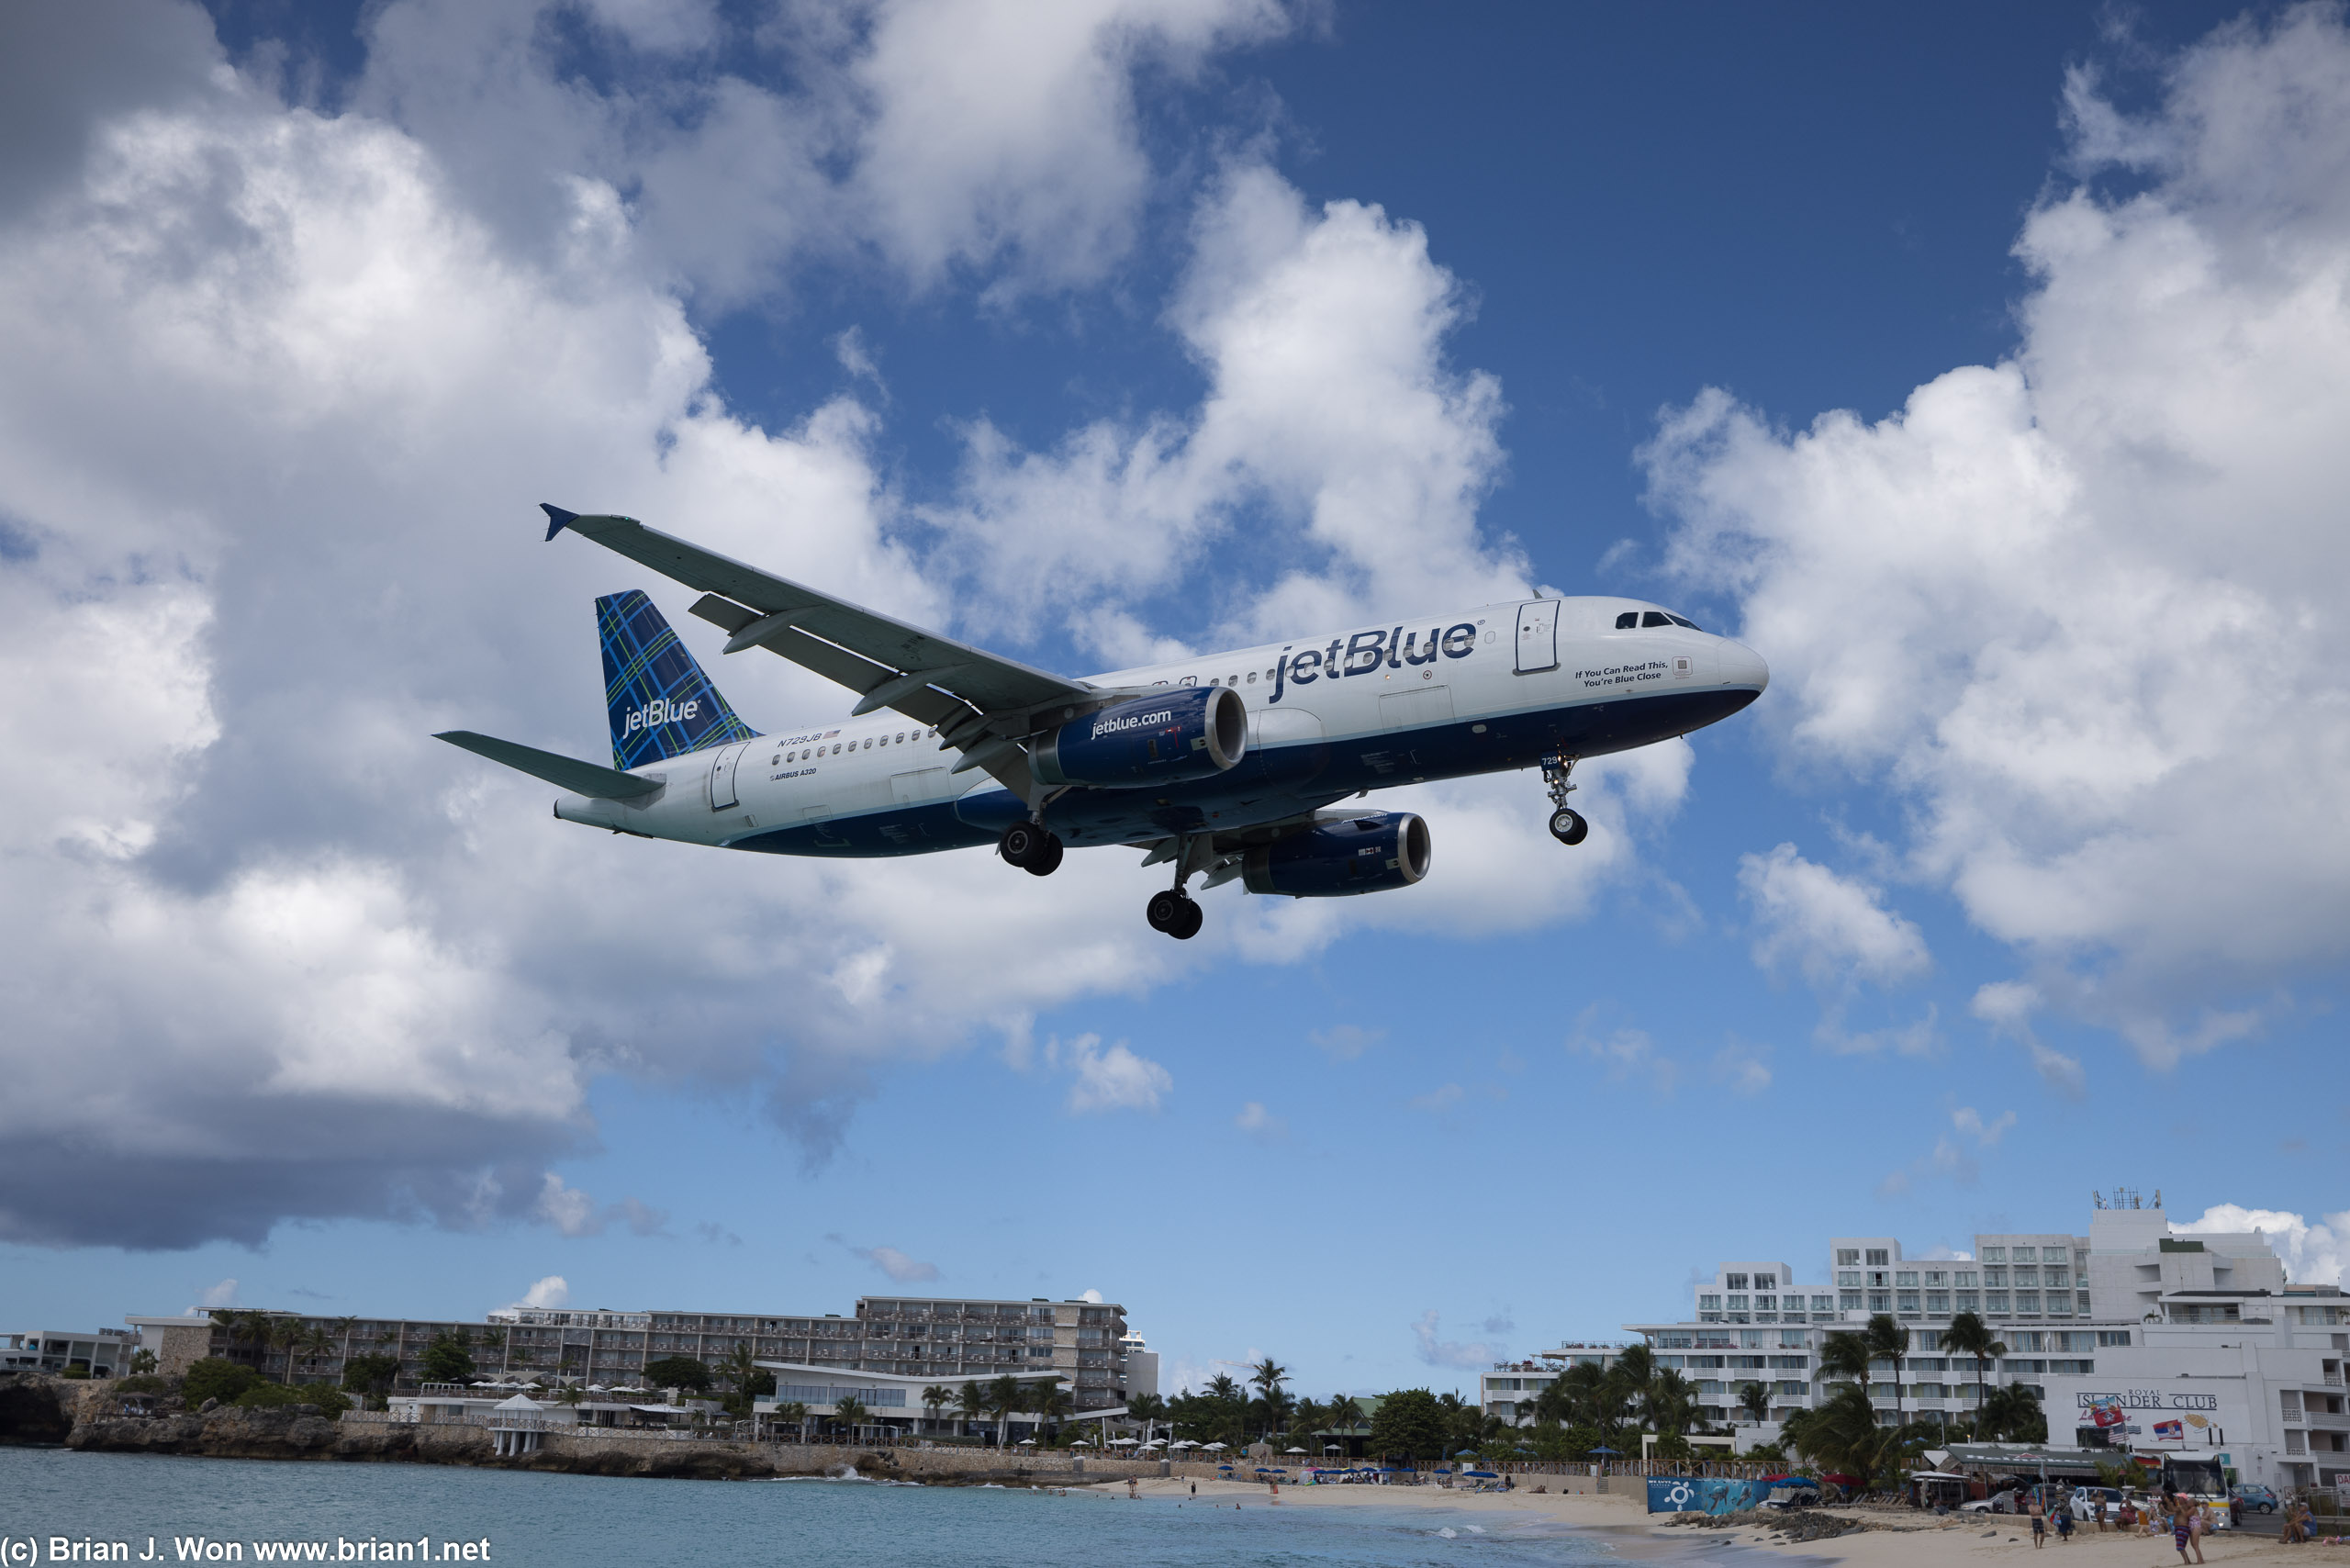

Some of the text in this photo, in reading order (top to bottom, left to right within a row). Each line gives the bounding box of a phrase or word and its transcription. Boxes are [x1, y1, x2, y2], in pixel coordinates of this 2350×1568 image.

[1623, 663, 1646, 673] Read
[1648, 661, 1668, 670] This,
[1615, 675, 1635, 684] Blue
[1637, 672, 1662, 680] Close
[1091, 711, 1171, 740] jetblue.com
[778, 733, 822, 747] N729JB
[1542, 756, 1558, 766] 729
[775, 767, 816, 780] AIRBUS A320
[2076, 1394, 2217, 1408] ISNDER CLUB
